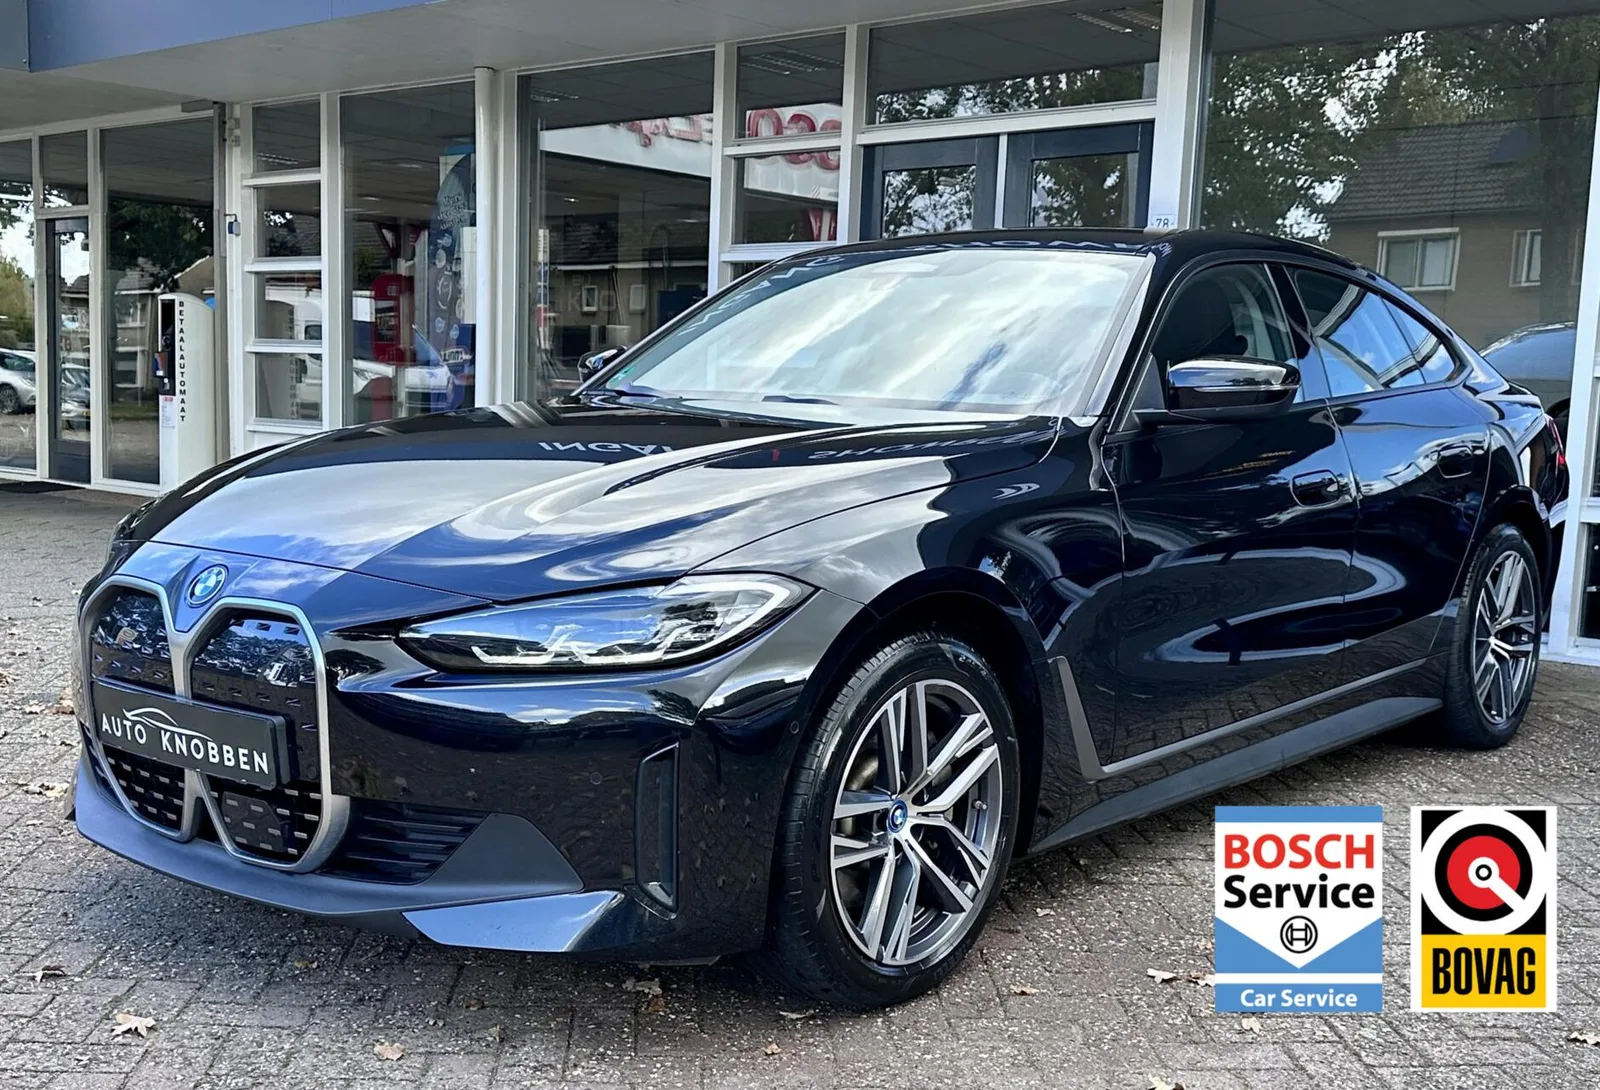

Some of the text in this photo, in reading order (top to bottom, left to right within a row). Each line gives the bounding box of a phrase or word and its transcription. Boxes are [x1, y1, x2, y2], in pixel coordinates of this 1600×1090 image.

[1156, 217, 1169, 228] 78
[102, 713, 269, 775] AUTO KNOBBEN
